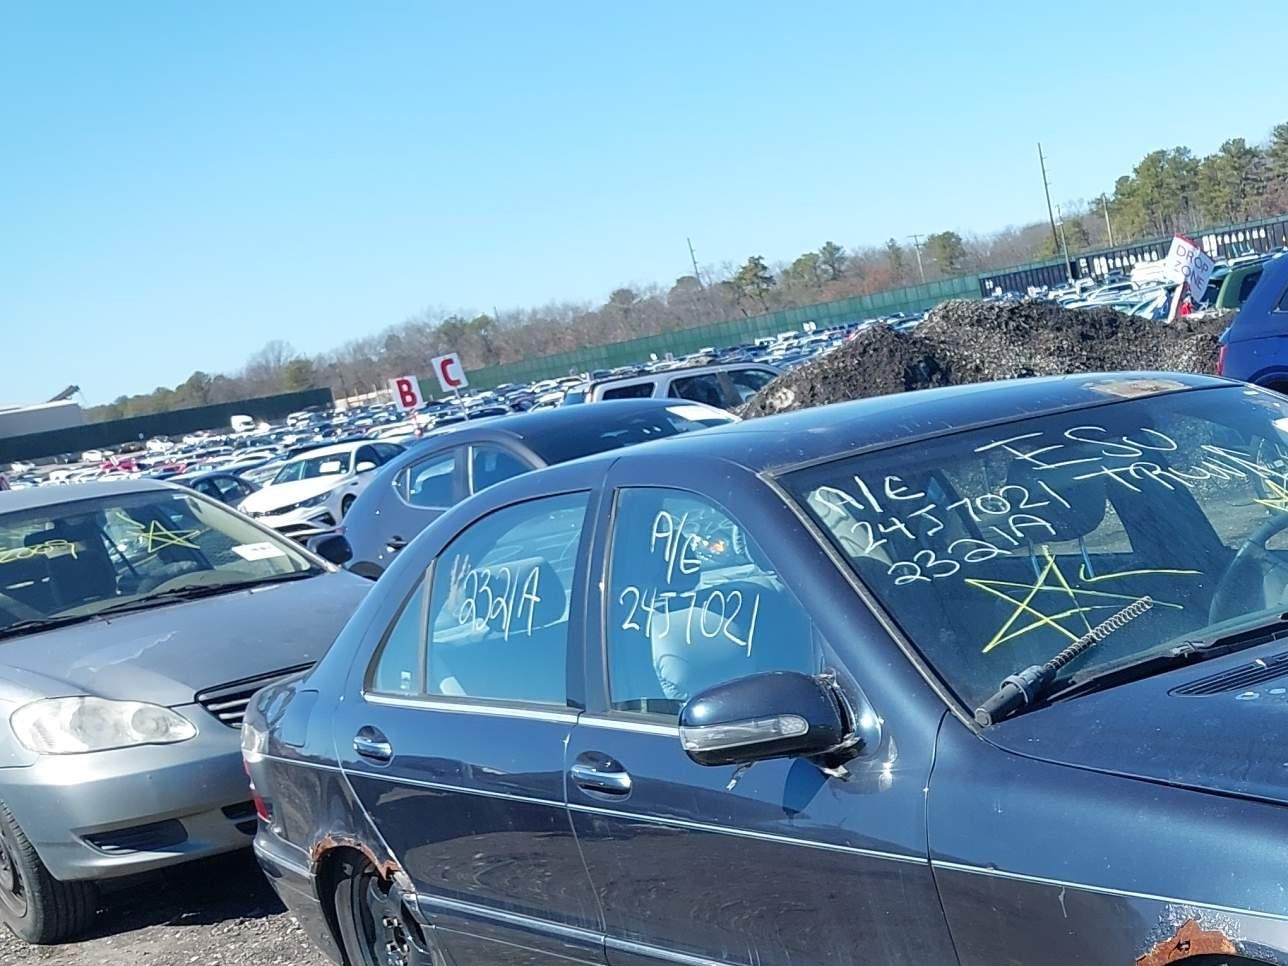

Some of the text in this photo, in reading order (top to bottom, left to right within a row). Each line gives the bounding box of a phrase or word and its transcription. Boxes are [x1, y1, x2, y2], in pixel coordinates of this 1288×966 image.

[1176, 245, 1209, 275] DROP
[1174, 261, 1204, 288] ZONE
[441, 358, 462, 387] C
[396, 379, 417, 407] B
